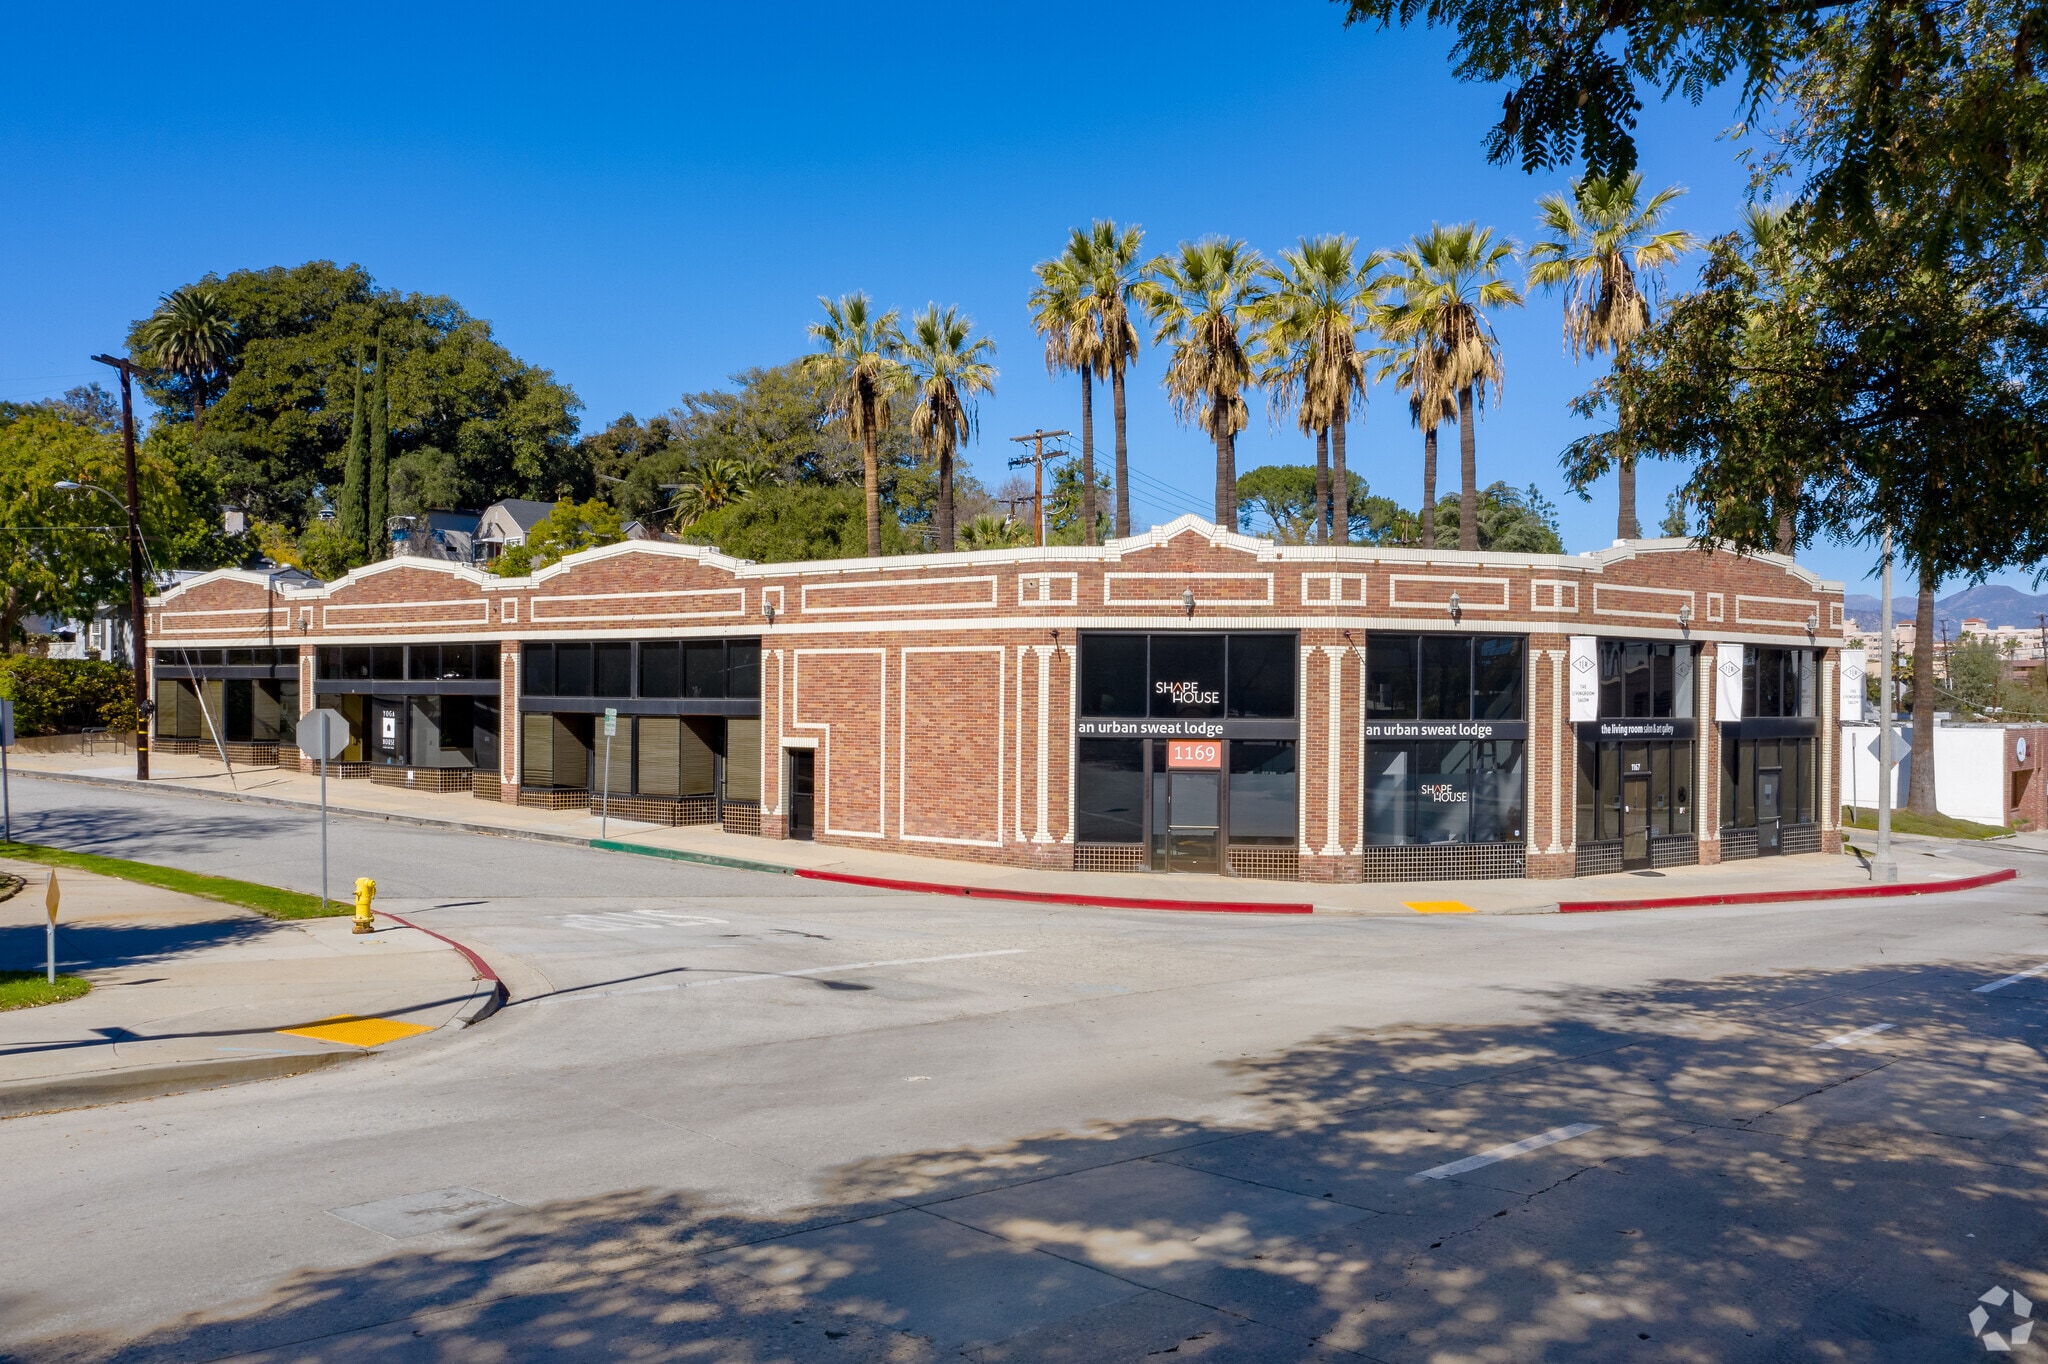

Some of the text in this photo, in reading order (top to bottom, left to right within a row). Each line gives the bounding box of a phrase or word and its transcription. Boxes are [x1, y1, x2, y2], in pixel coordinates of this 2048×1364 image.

[1156, 682, 1198, 694] SHAPE
[1173, 692, 1220, 704] HOUSE
[1078, 721, 1223, 737] an urban sweat lodge
[1366, 724, 1492, 738] an urban sweat lodge
[1601, 724, 1611, 734] the
[1612, 724, 1628, 736] living
[1174, 745, 1215, 762] 1169
[1421, 784, 1452, 794] SHAPE
[1434, 792, 1467, 802] HOUSE
